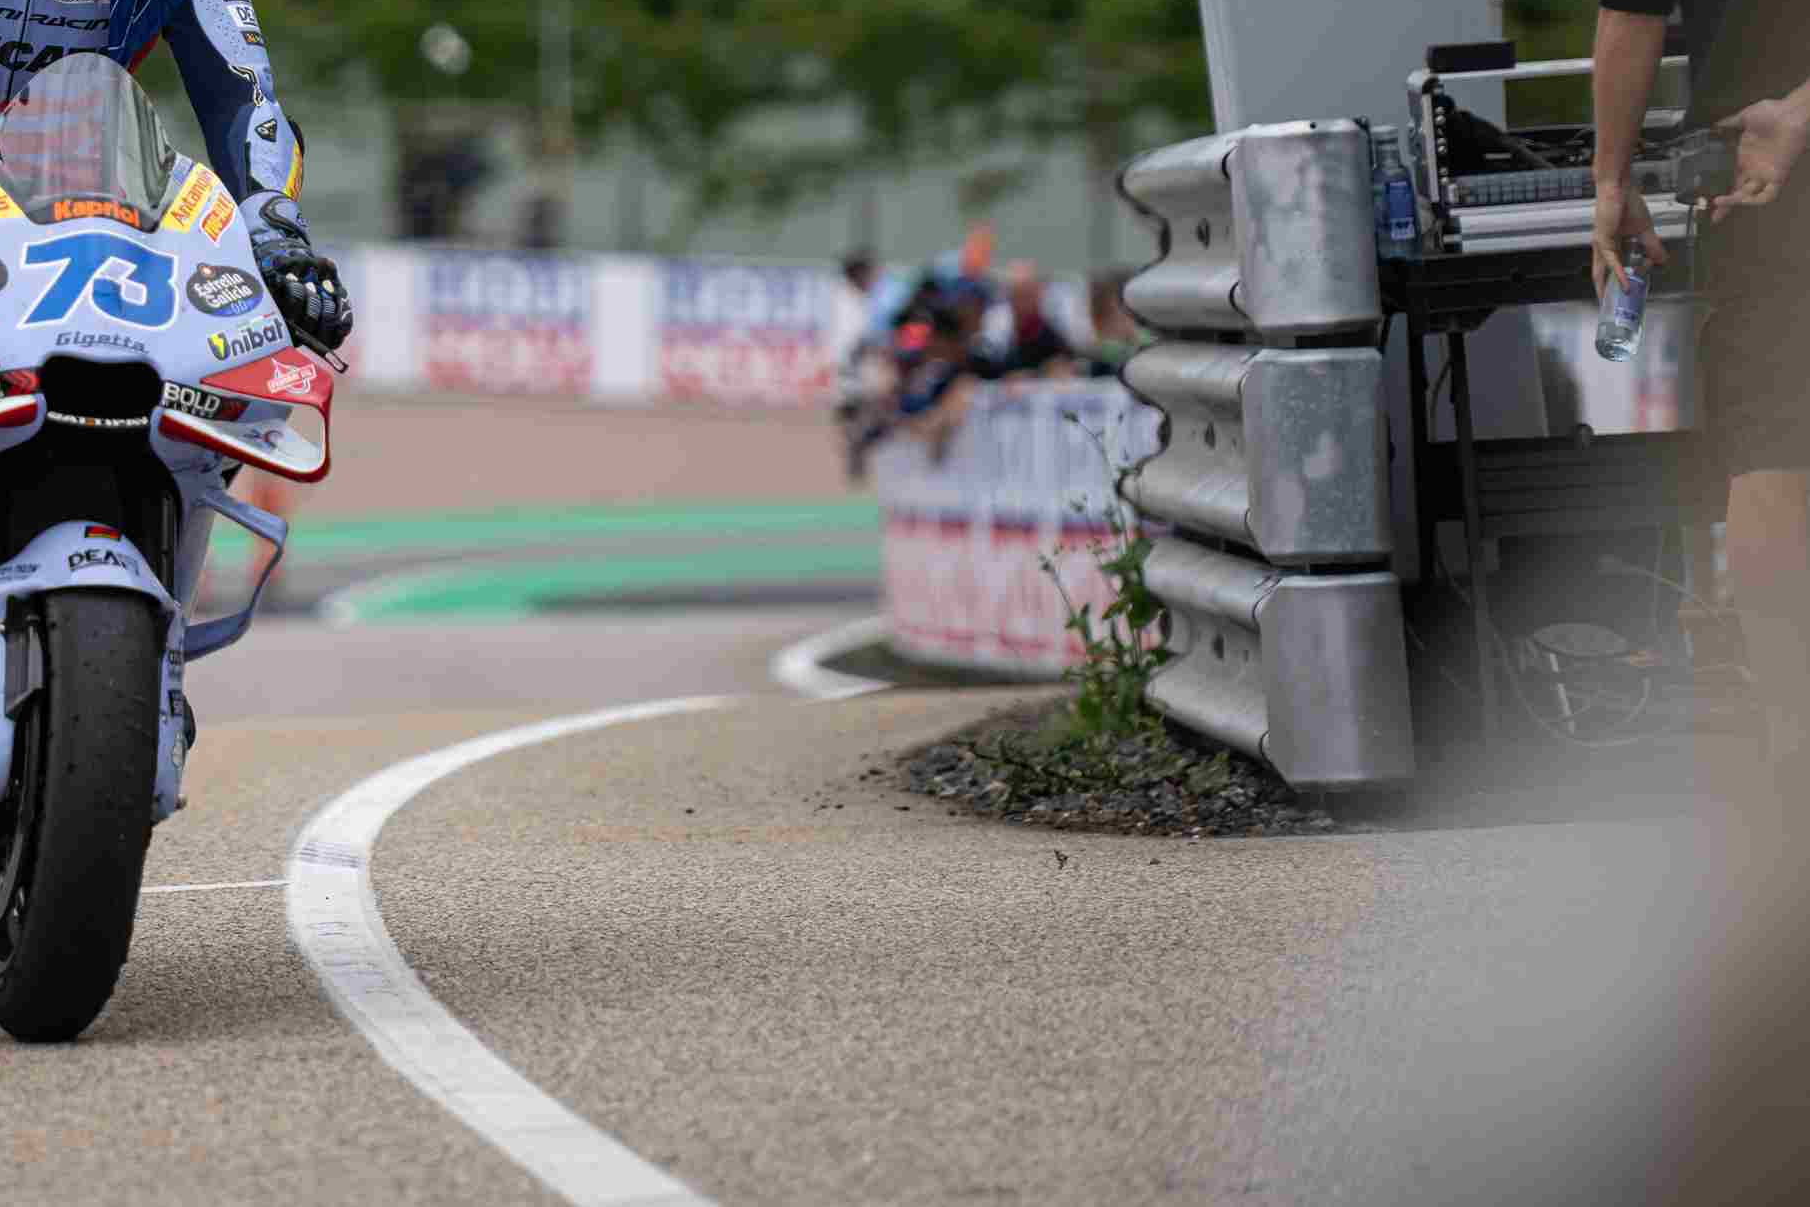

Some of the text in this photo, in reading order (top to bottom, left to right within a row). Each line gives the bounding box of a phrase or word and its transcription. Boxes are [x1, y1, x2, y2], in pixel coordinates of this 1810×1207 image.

[53, 199, 139, 228] Kapriol
[17, 230, 179, 331] 73
[193, 273, 244, 298] Estrella
[204, 284, 254, 309] Galicia
[206, 319, 285, 361] Unibat
[163, 381, 221, 413] BOLD
